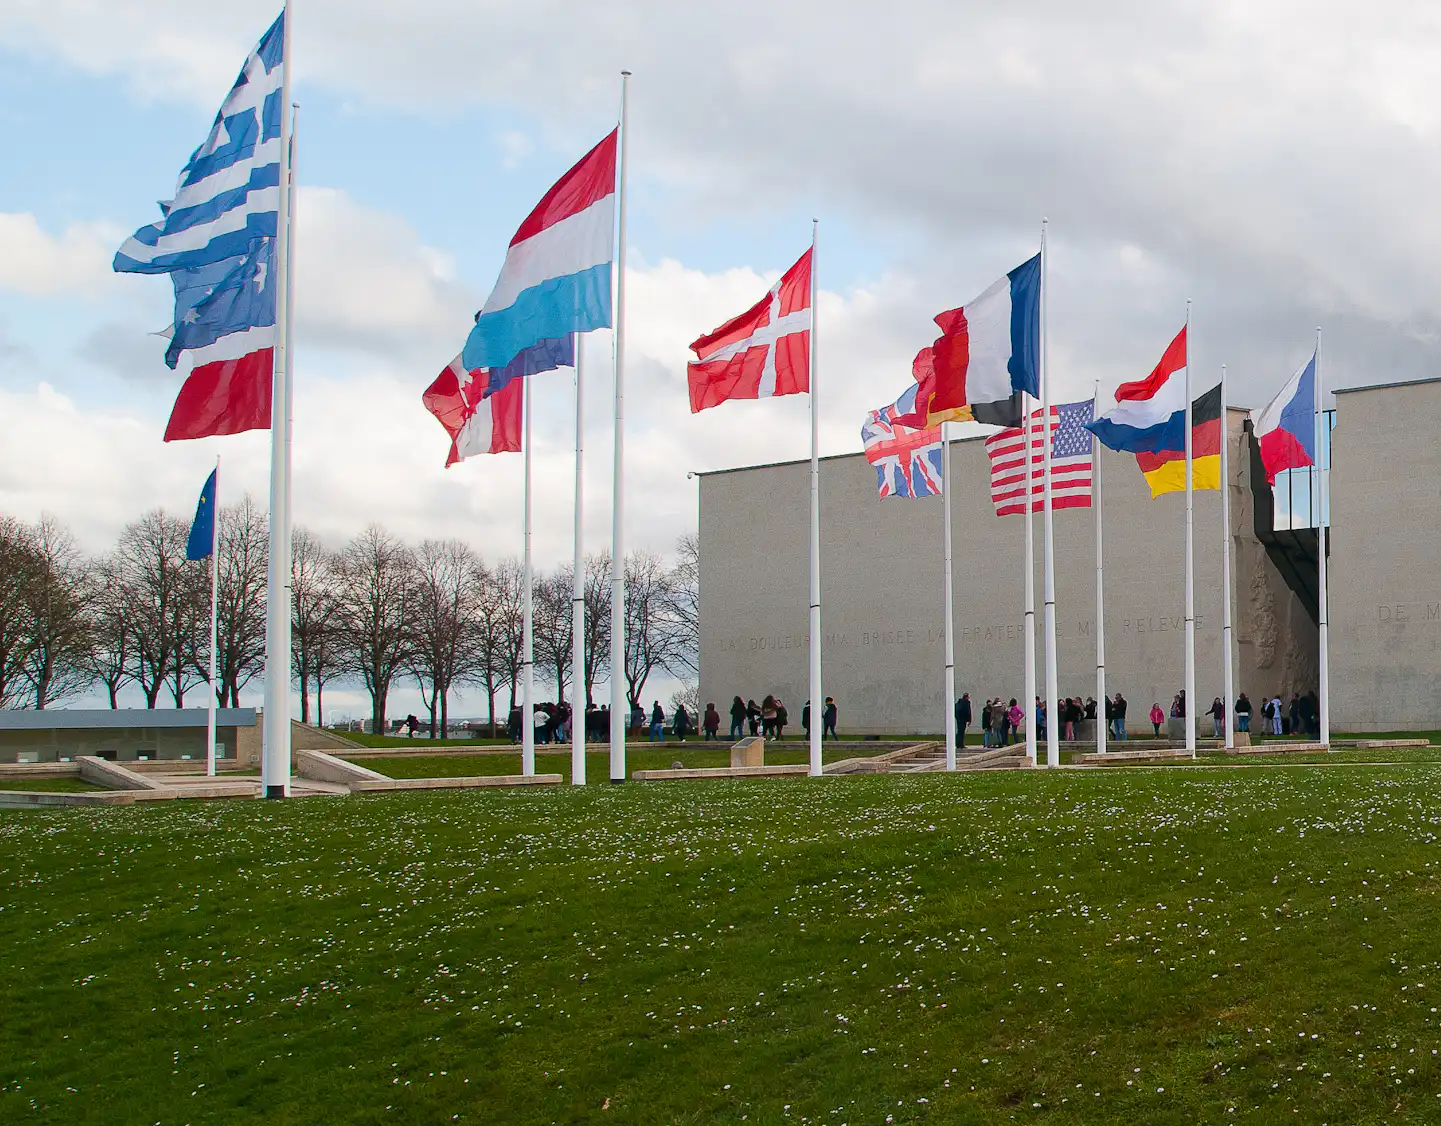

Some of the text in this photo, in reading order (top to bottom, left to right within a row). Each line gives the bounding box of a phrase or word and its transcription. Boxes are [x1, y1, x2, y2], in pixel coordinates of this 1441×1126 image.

[1378, 604, 1406, 622] DE
[720, 639, 736, 652] LA
[928, 629, 946, 643] LA
[1123, 615, 1204, 633] RELEVE
